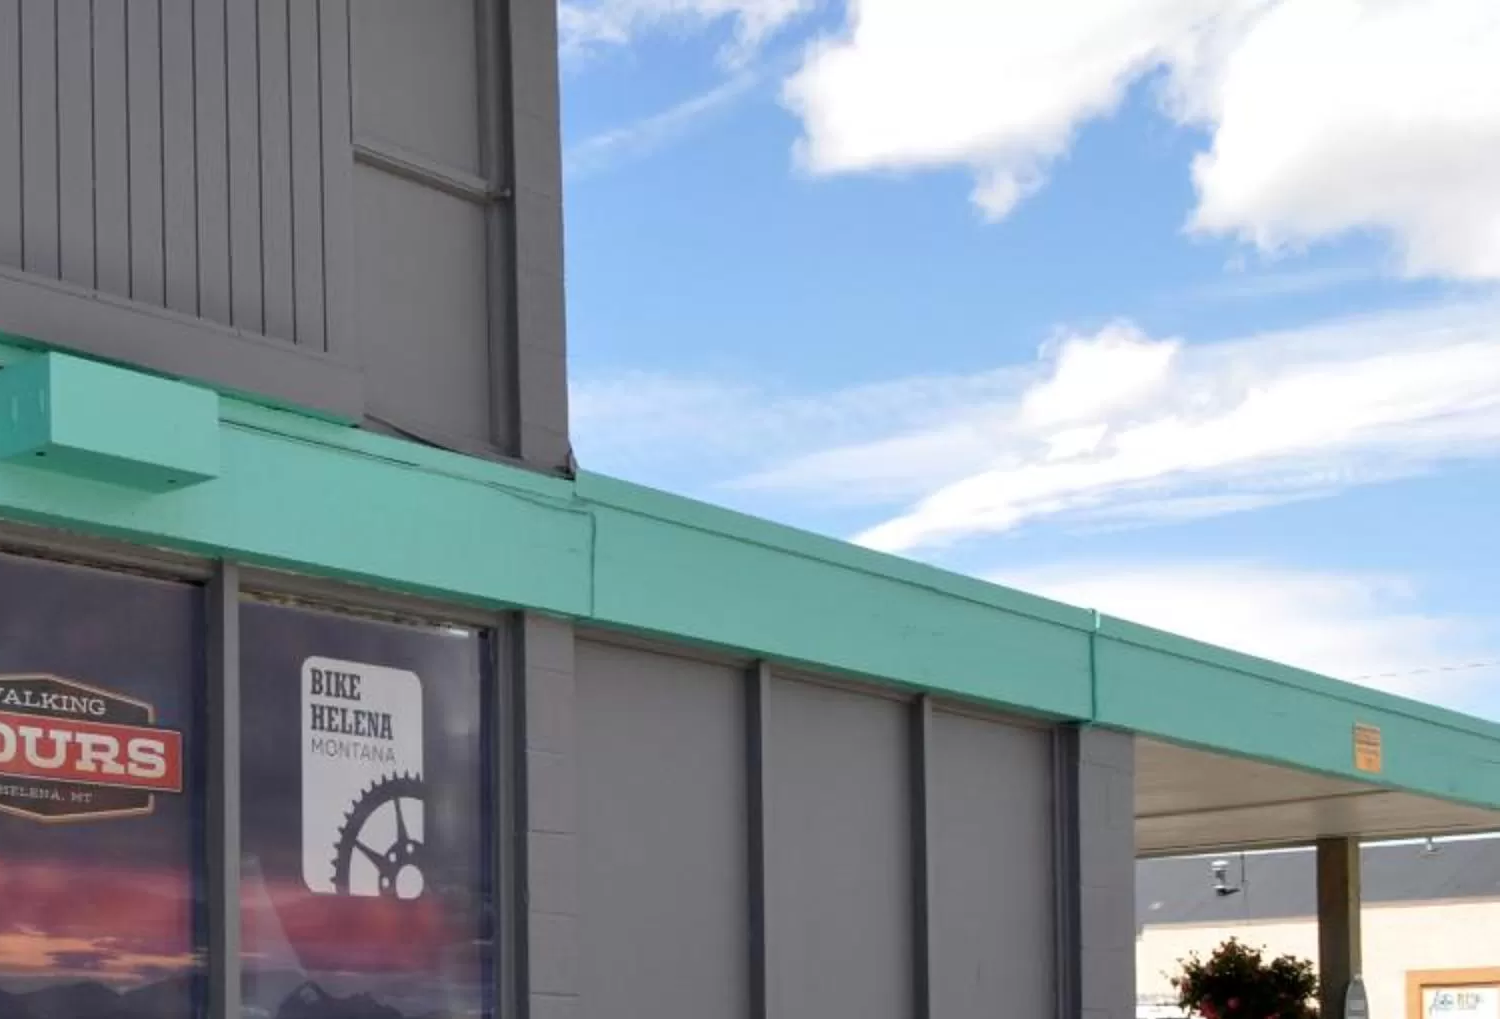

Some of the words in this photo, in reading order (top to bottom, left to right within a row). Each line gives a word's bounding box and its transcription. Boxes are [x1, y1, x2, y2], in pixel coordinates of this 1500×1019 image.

[310, 667, 362, 701] BIKE
[310, 703, 394, 740] HELENA
[310, 736, 397, 764] MONTANA
